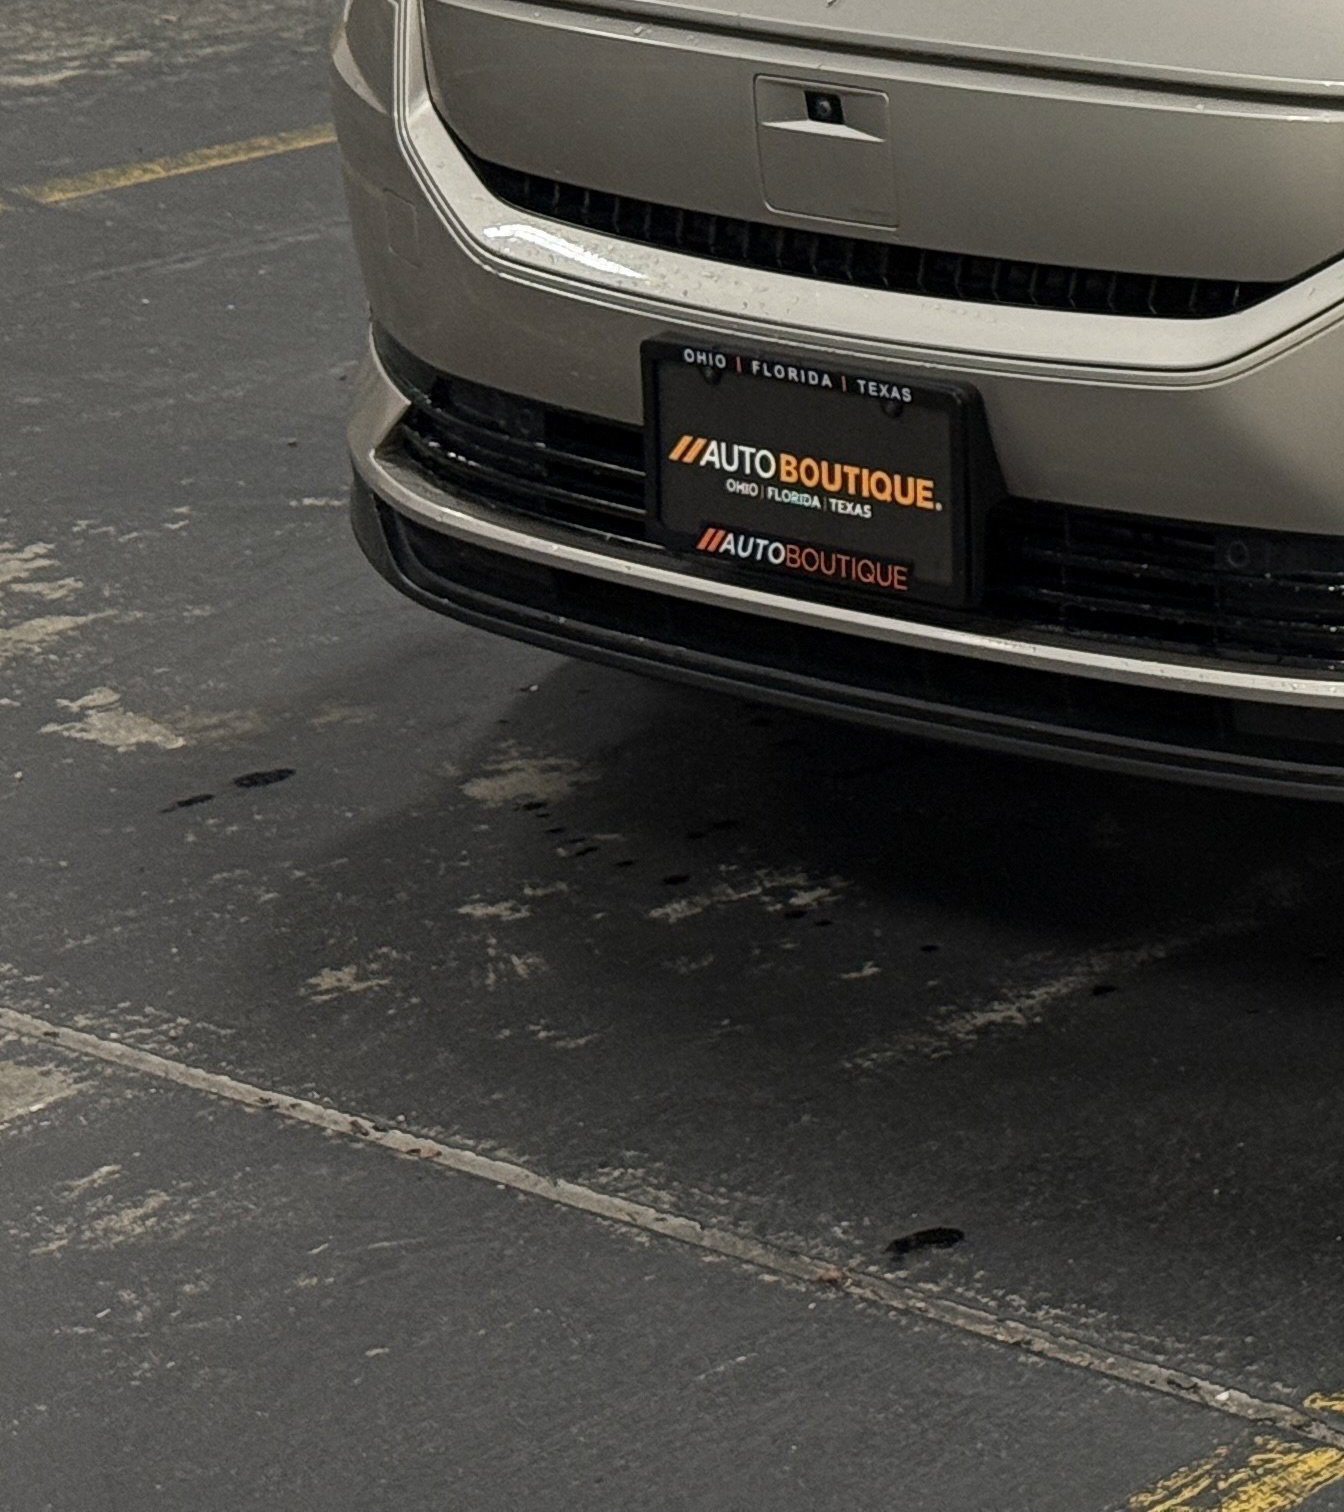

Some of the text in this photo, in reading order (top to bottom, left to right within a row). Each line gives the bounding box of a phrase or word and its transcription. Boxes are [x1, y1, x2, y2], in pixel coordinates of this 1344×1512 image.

[683, 348, 727, 369] OHIO
[751, 360, 833, 388] FLORIDA
[856, 379, 913, 403] TEXAS
[726, 478, 759, 497] OHIO
[766, 486, 822, 510] FLORIDA
[828, 497, 873, 519] TEXAS
